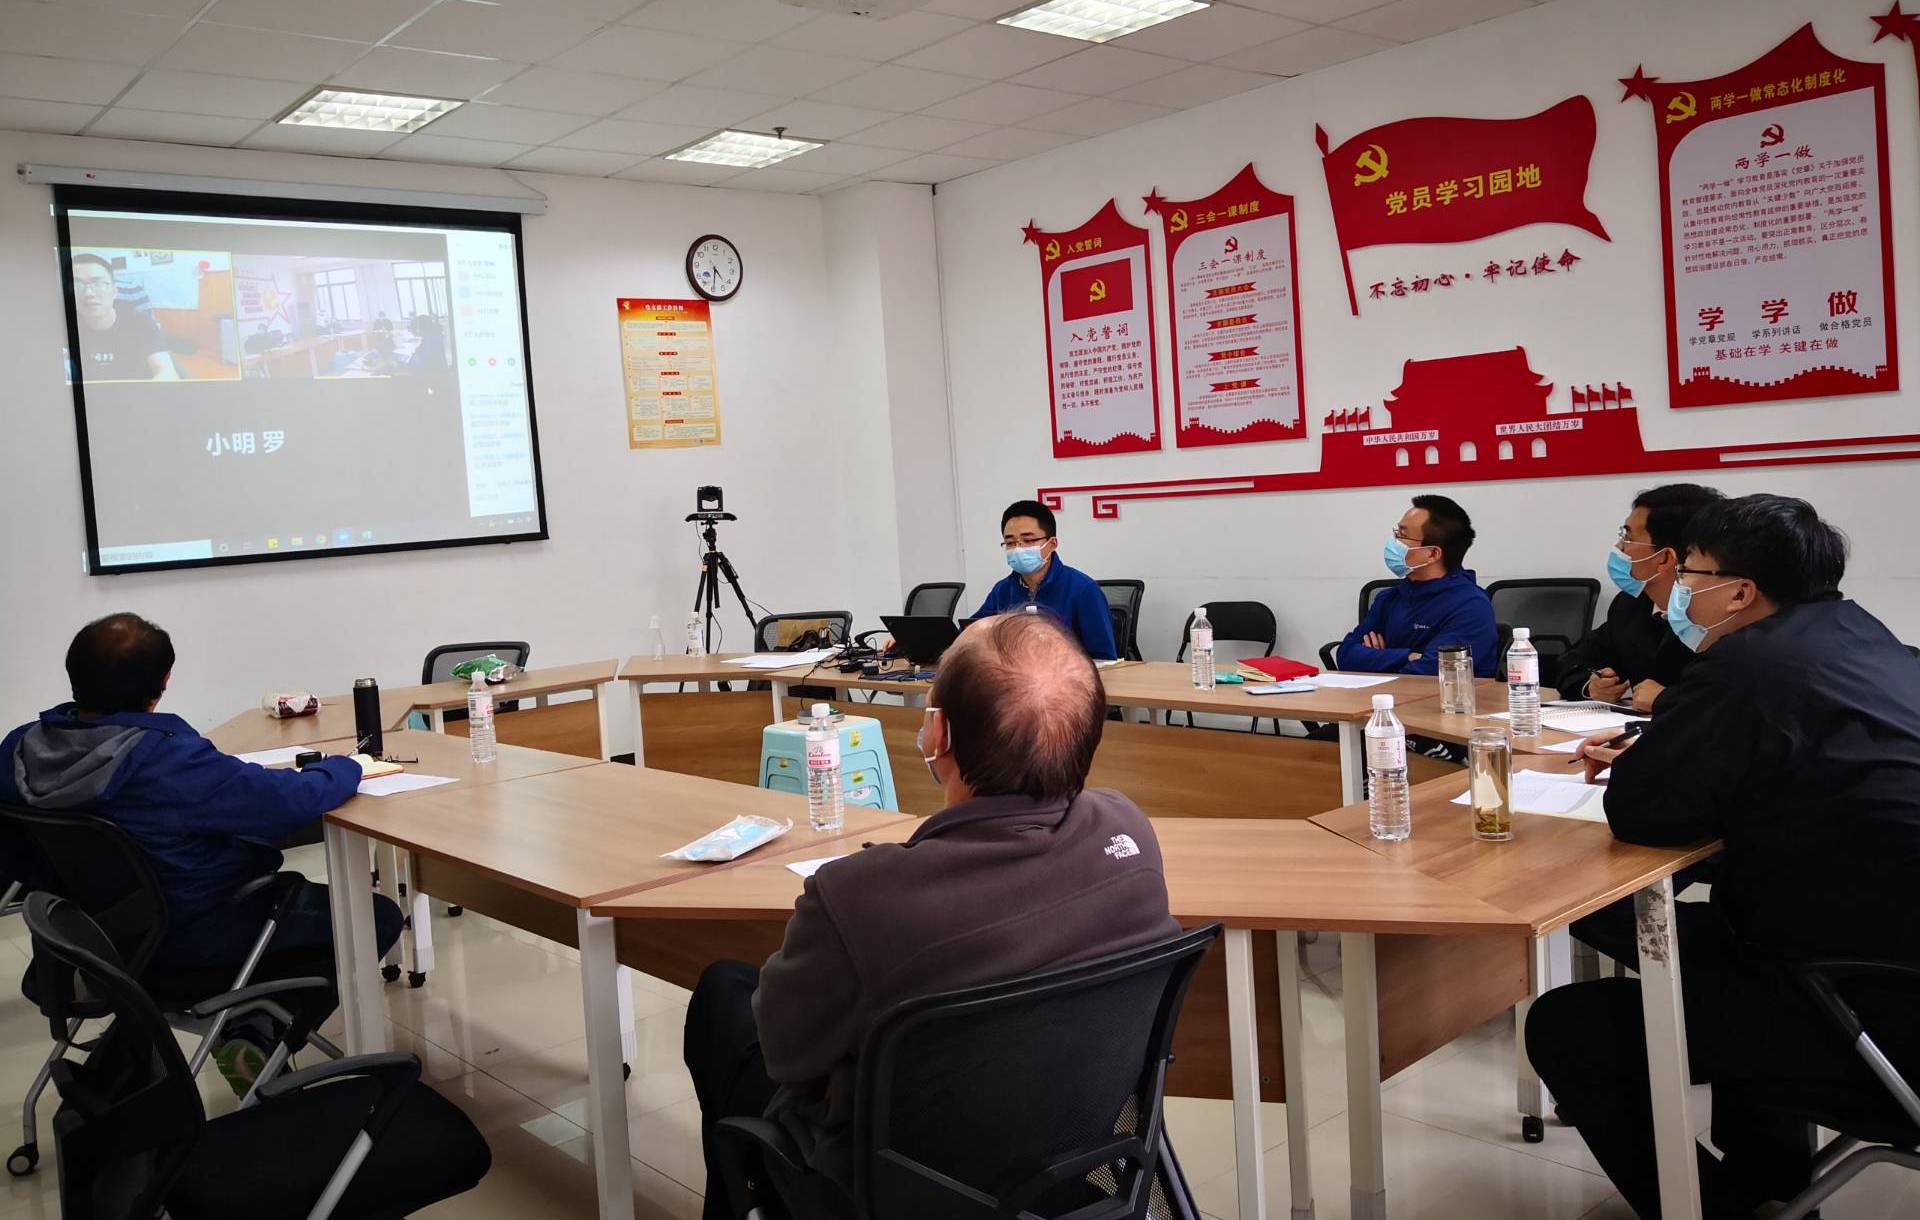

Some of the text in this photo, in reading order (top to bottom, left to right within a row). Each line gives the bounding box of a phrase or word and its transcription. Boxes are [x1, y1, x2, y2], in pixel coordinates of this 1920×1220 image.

[1710, 69, 1848, 111] 两学一做常态化制度化
[1735, 145, 1815, 170] 两学一做
[1385, 163, 1543, 216] 党员学习园地
[1196, 200, 1260, 225] 三会一课制度
[1067, 237, 1102, 254] 入党誓词
[1198, 248, 1267, 271] 三会一课制度
[1761, 298, 1790, 324] 学
[1826, 289, 1859, 318] 做
[1698, 306, 1725, 332] 学
[1819, 316, 1872, 332] 做合格党员
[1070, 322, 1129, 343] 入党誓词
[1689, 332, 1737, 346] 学党章党规
[1751, 325, 1801, 340] 学系列讲话
[1714, 337, 1839, 361] 基础在学 关键在做
[1365, 431, 1436, 445] 中华人民共和国万岁
[1499, 419, 1580, 434] 世界人民大团结万岁
[206, 430, 285, 456] 小明 罗
